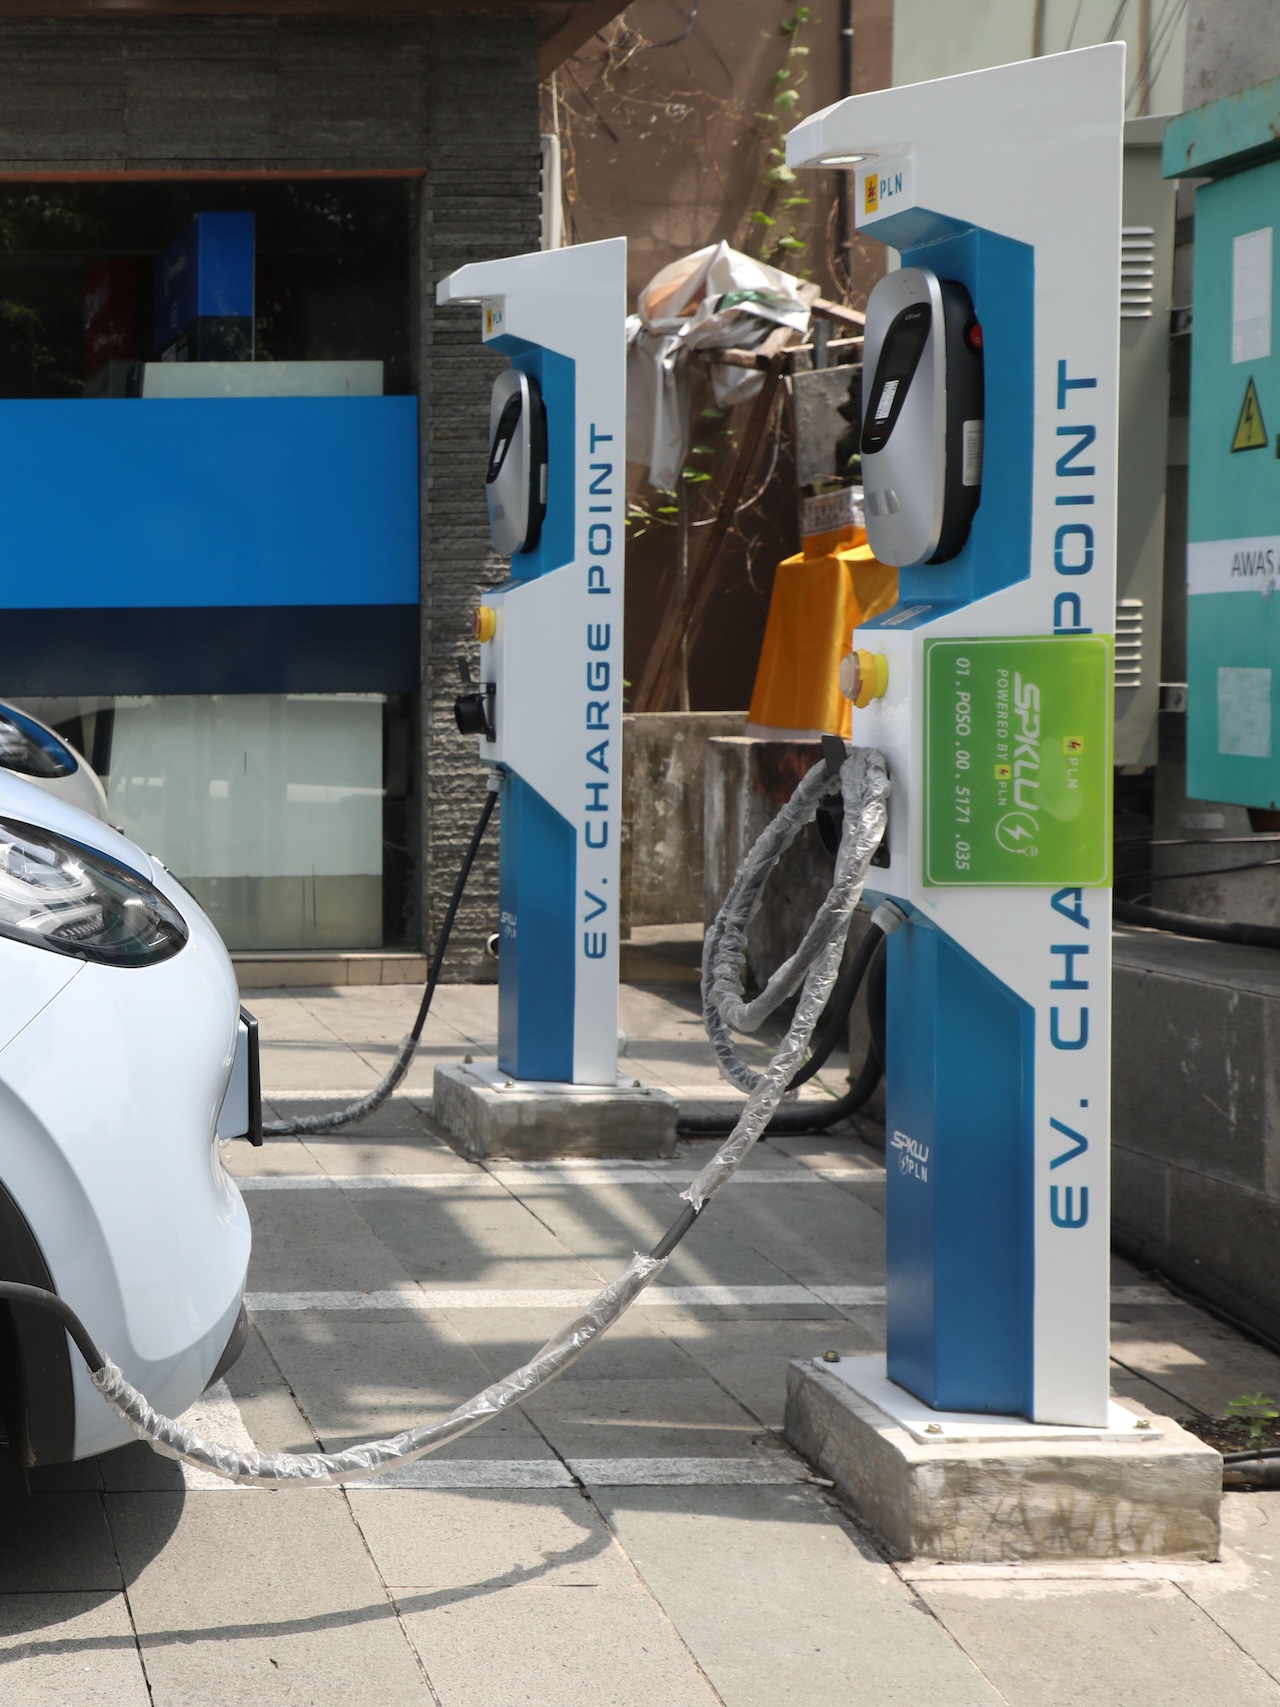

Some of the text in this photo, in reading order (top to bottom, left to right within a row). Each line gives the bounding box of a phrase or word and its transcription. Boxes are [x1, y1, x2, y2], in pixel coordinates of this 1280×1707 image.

[880, 172, 903, 200] PLN
[1053, 359, 1098, 635] POINT
[1230, 549, 1275, 577] AWAS
[584, 423, 614, 959] EV. CHARGE POINT
[996, 669, 1009, 806] POWERED BY PLN
[1014, 671, 1040, 811] SPKLU
[1067, 757, 1079, 789] PLN
[908, 1157, 928, 1183] PLN
[1050, 1098, 1089, 1229] EV.
